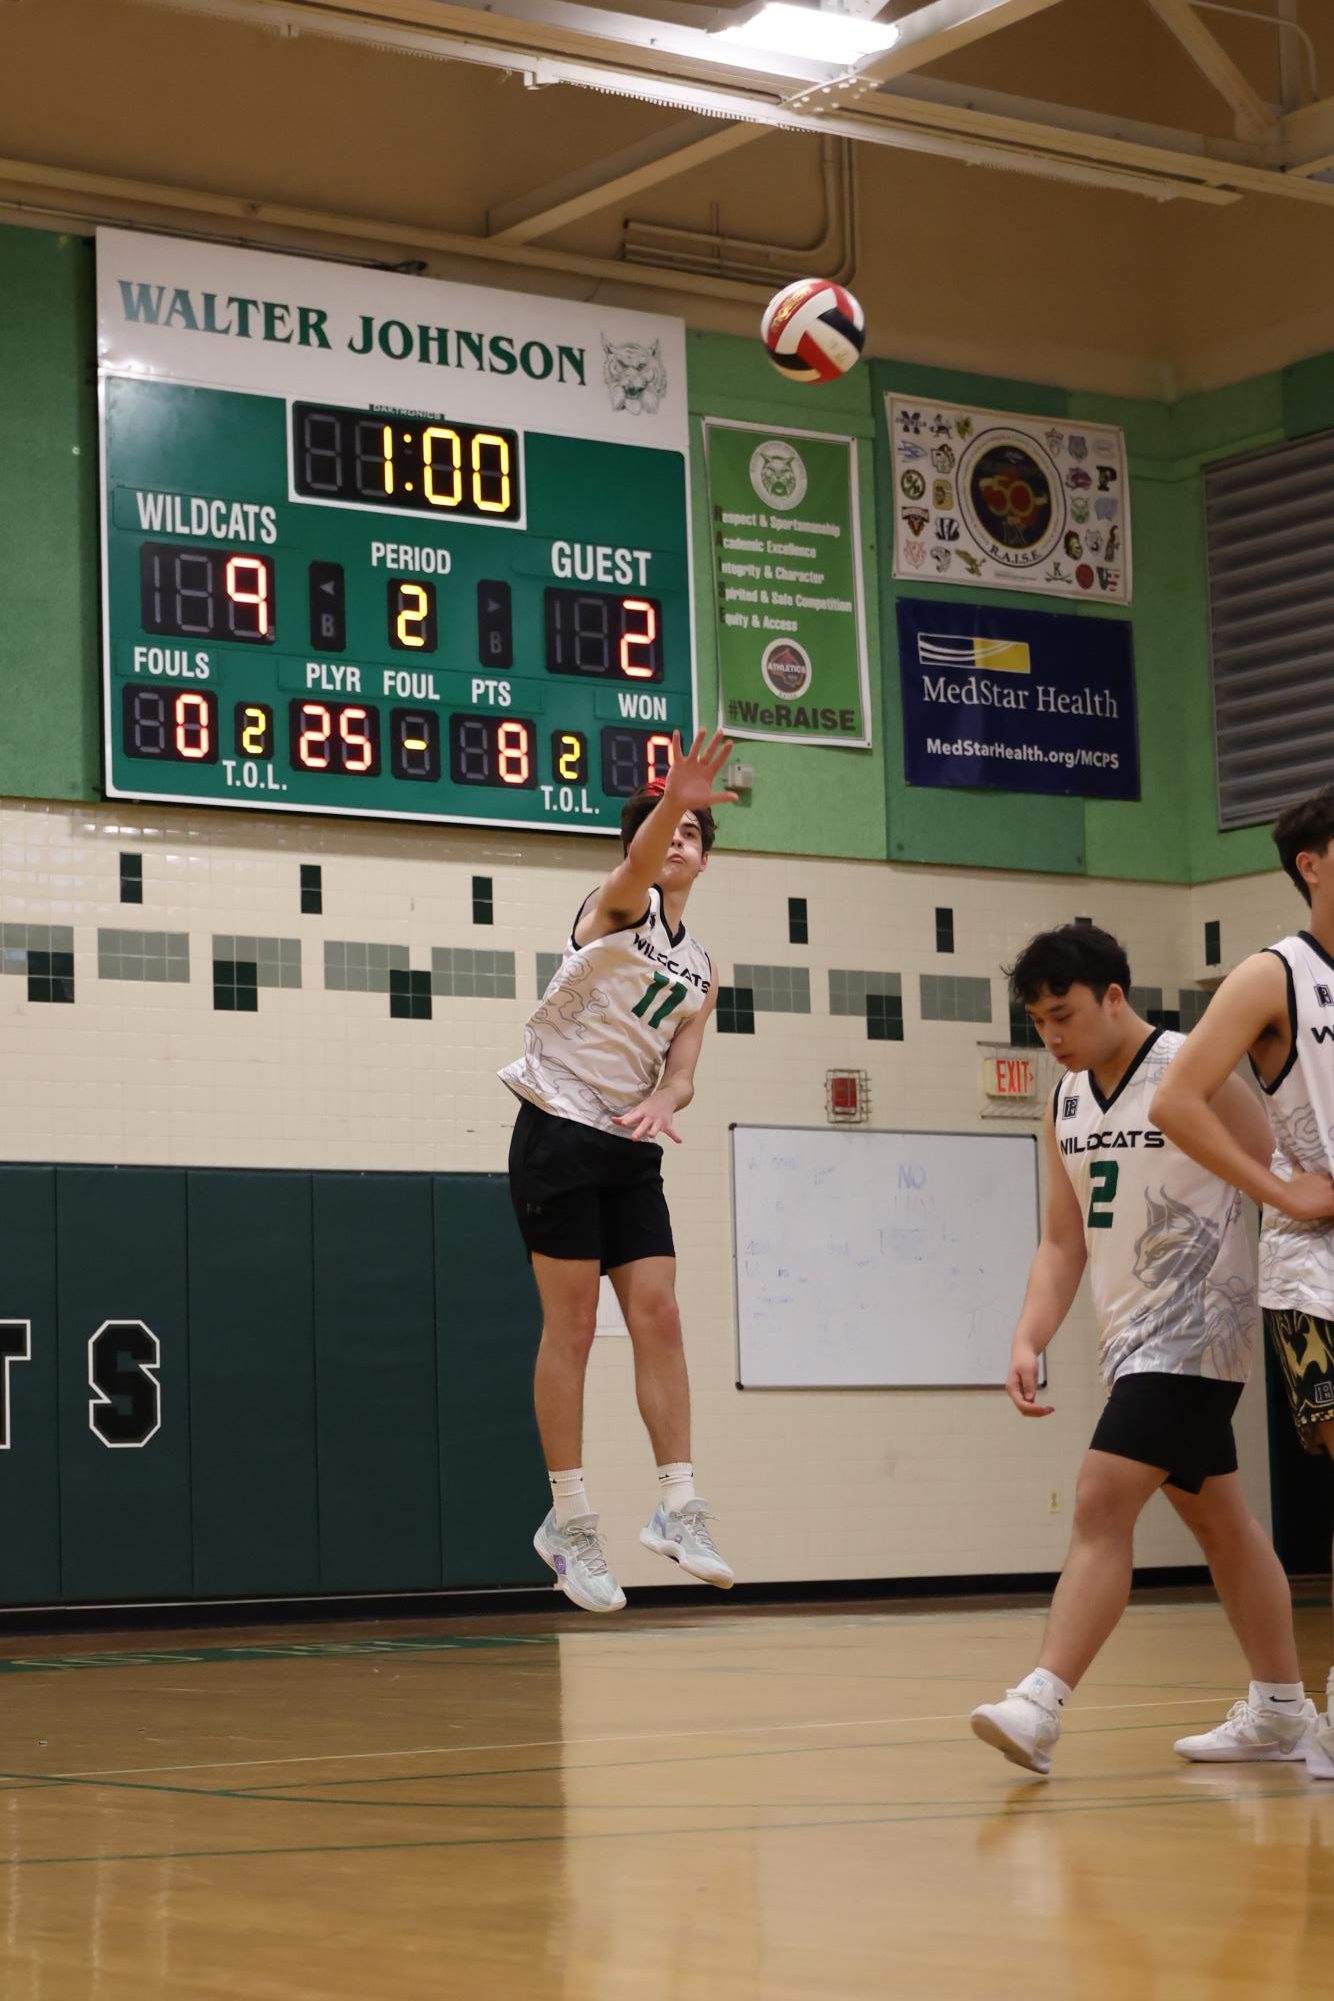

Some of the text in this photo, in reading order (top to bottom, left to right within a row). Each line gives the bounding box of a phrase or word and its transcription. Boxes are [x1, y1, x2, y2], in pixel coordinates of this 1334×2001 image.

[118, 280, 588, 386] WALTER JOHNSON
[383, 425, 510, 513] 1:00
[136, 493, 277, 544] WILDCATS
[759, 514, 767, 527] &
[371, 541, 451, 575] PERIOD
[551, 541, 651, 586] GUEST
[764, 565, 772, 579] &
[226, 556, 268, 635] 9
[397, 584, 428, 647] 2
[760, 590, 769, 603] &
[620, 600, 655, 677] 2
[751, 614, 760, 628] &
[133, 646, 210, 680] FOULS
[306, 663, 511, 706] PLYR FOUL PTS
[618, 693, 667, 721] WON
[728, 700, 856, 731] #WeRAISE
[922, 675, 1119, 719] MedStar Health
[175, 694, 209, 758] 0
[243, 708, 266, 754] 2
[300, 704, 372, 771] 25
[497, 722, 529, 784] 8
[559, 736, 580, 780] 2
[926, 738, 1120, 769] MedStarHealth.org/MCPS
[223, 760, 288, 791] T.O.L.
[540, 786, 600, 815] T.O.L.
[633, 932, 711, 994] WILDCATS
[631, 970, 688, 1030] 11
[996, 1059, 1029, 1093] EXIT
[1087, 1160, 1119, 1229] 2
